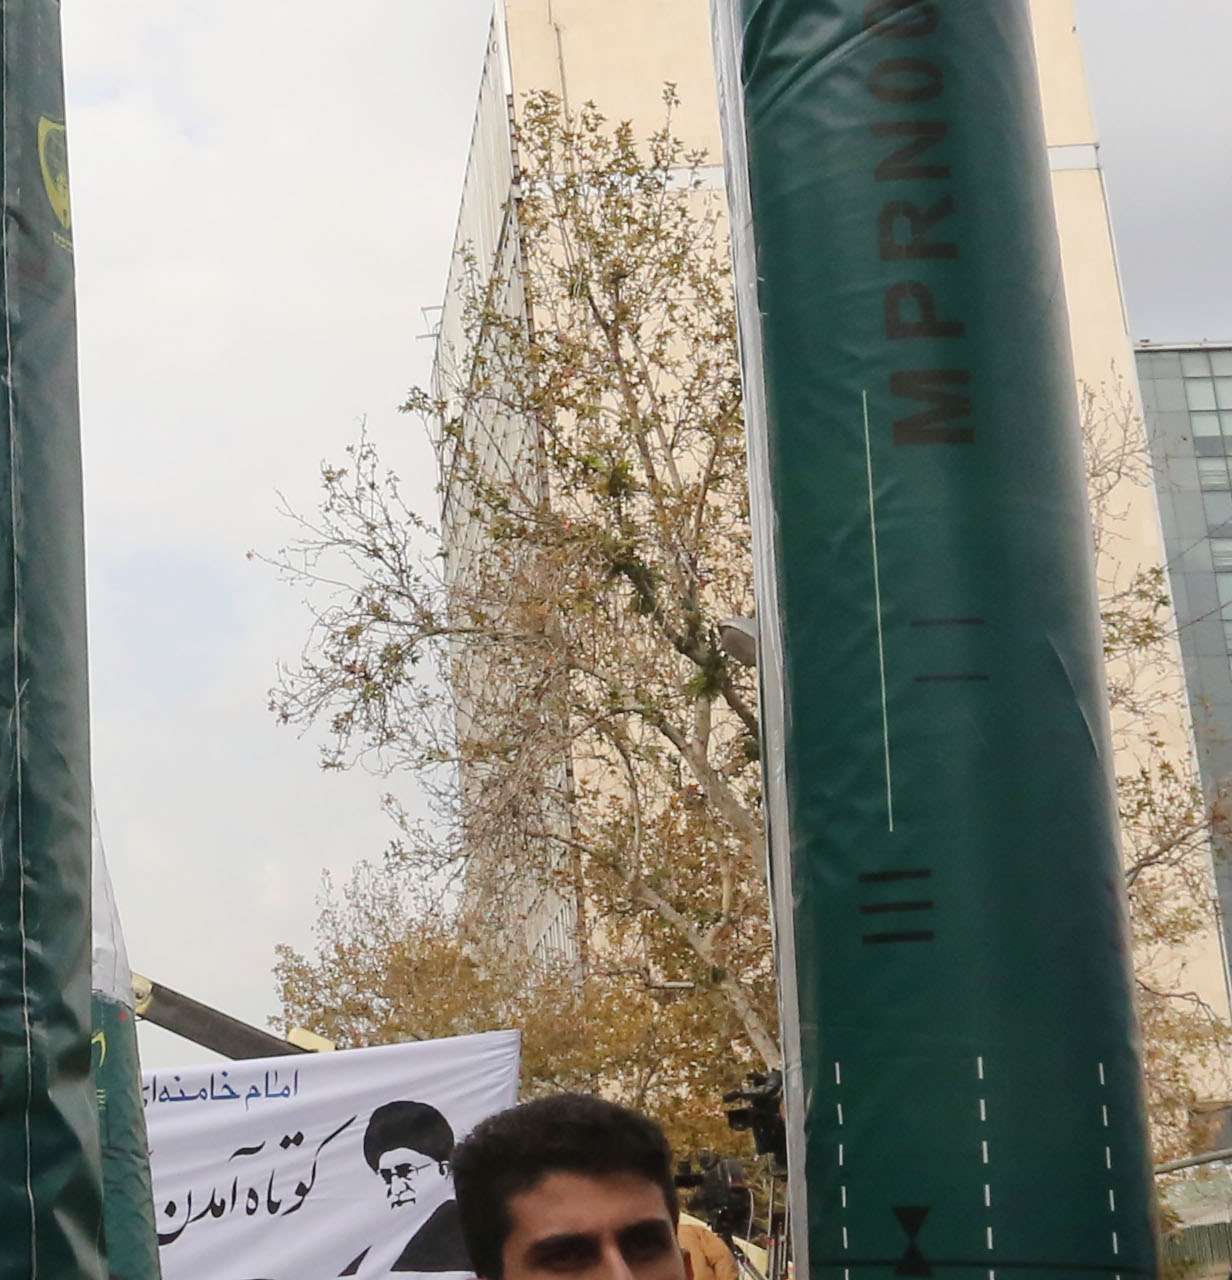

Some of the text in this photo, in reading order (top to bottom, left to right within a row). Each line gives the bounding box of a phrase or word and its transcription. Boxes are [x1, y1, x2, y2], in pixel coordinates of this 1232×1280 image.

[246, 1069, 299, 1111] امام
[159, 1115, 358, 1247] کوتاه آمدن
